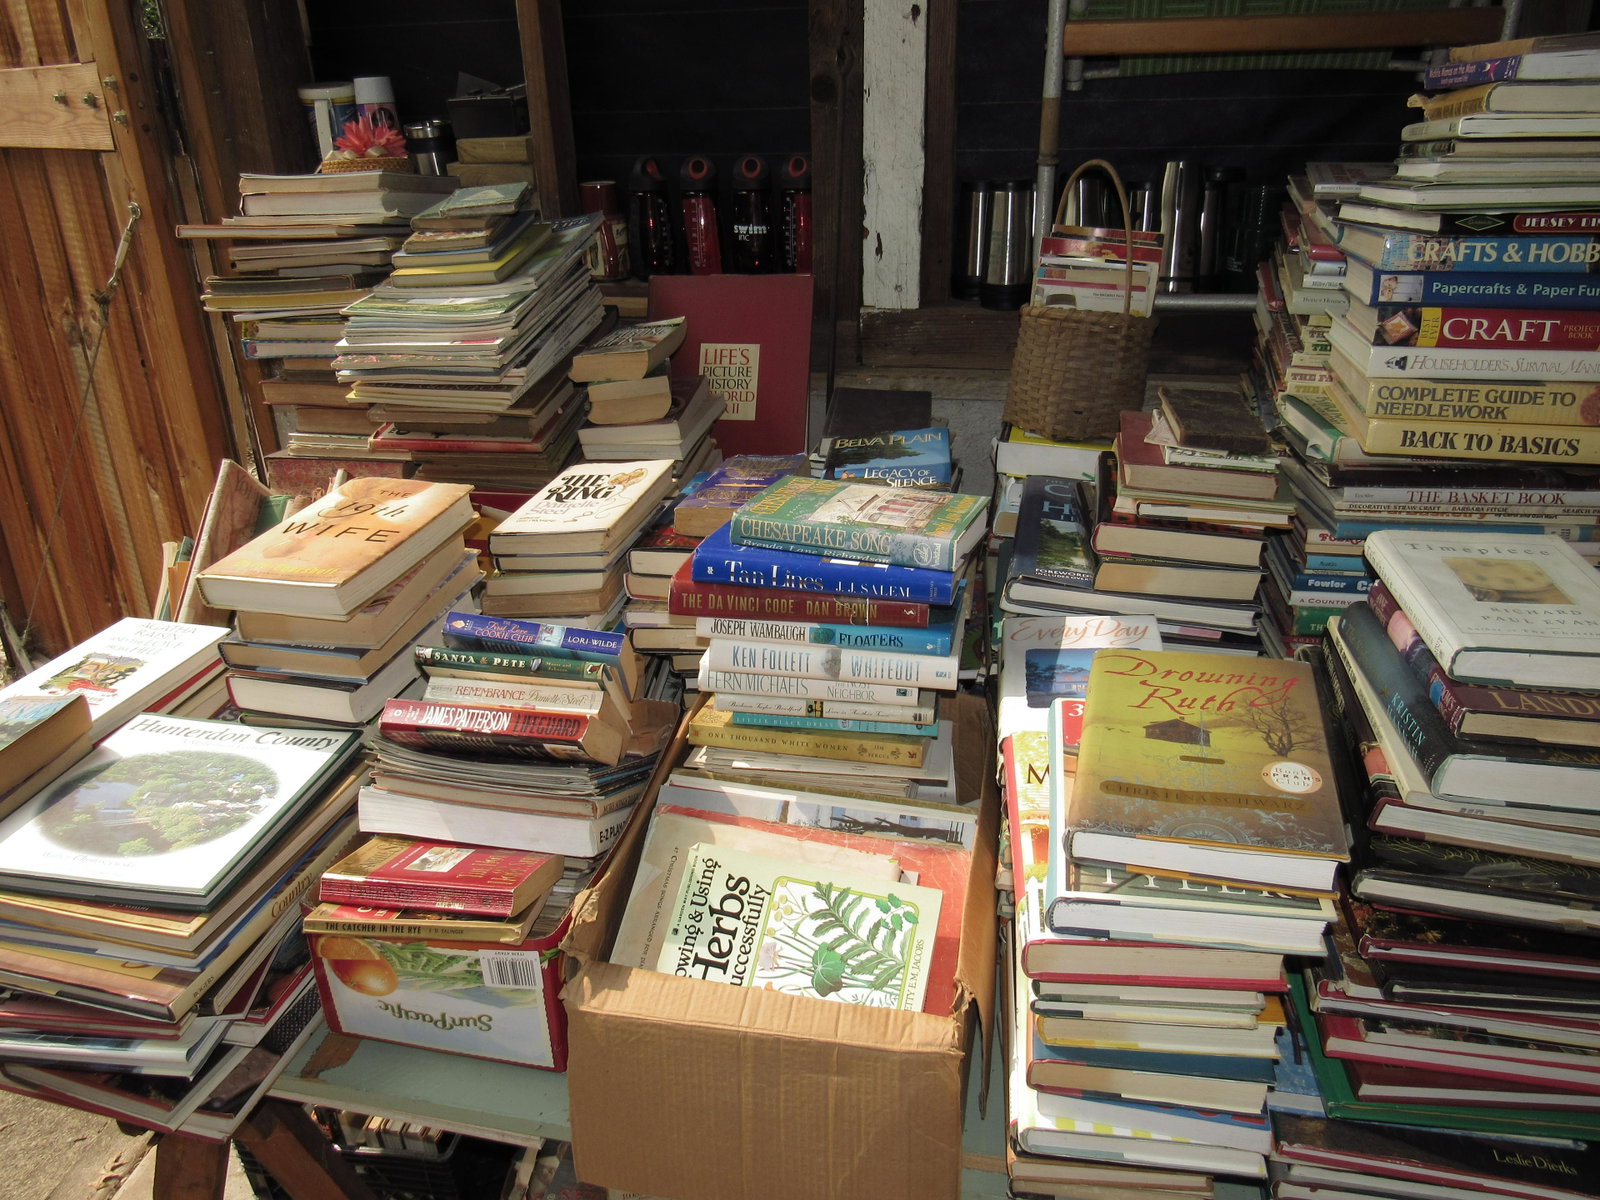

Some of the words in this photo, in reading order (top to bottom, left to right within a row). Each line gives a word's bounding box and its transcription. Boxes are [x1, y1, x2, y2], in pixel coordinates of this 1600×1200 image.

[734, 224, 768, 235] swim
[1522, 218, 1576, 228] JERSEY
[1408, 241, 1498, 263] CRAFTS
[1502, 242, 1522, 263] &
[1432, 281, 1511, 296] Papercrafts
[1516, 283, 1527, 295] &
[1533, 283, 1575, 298] Paper
[1421, 319, 1430, 338] BEST
[1430, 317, 1440, 339] EVER
[1442, 317, 1560, 342] CRAFT
[704, 347, 750, 366] LIFE'S
[702, 366, 752, 377] PICTURE
[1377, 385, 1482, 405] COMPLETE
[1485, 389, 1544, 406] GUIDE
[1548, 391, 1577, 407] TO
[1375, 401, 1509, 420] NEEDLEWORK
[835, 436, 885, 449] BELVA
[889, 432, 941, 445] PLAIN
[1400, 430, 1457, 450] BACK
[1463, 433, 1493, 452] TO
[1499, 435, 1580, 457] BASICS
[562, 474, 610, 488] THE
[864, 468, 916, 479] LEGACY
[917, 469, 930, 477] OF
[886, 475, 937, 489] SILENCE
[378, 488, 412, 499] THE
[544, 485, 616, 504] RING
[1406, 490, 1443, 503] THE
[1448, 491, 1514, 504] BASKET
[1518, 492, 1566, 505] BOOK
[317, 501, 406, 519] 19th
[282, 521, 401, 544] WIFE
[741, 518, 846, 549] CHESAPEAKE
[850, 531, 892, 555] SONG
[742, 539, 783, 550] Brenda
[789, 545, 819, 555] Lane
[823, 551, 890, 564] Richardson
[1405, 542, 1552, 556] Timepiece
[725, 560, 764, 586] Tan
[771, 564, 824, 591] Lines
[835, 580, 844, 593] J.
[848, 582, 857, 594] J.
[861, 583, 911, 599] SALEM
[1308, 580, 1346, 588] Fowler
[681, 593, 703, 609] THE
[708, 595, 724, 610] DA
[725, 595, 759, 611] VINCI
[764, 598, 795, 614] CODE
[806, 600, 830, 616] DAN
[835, 601, 878, 619] BROWN
[1490, 607, 1582, 616] RICHARD
[1481, 615, 1534, 625] PAUL
[475, 629, 509, 640] COOKIE
[511, 633, 534, 643] CLUB
[711, 618, 746, 636] JOSEPH
[750, 621, 806, 642] WAMBAUGH
[839, 633, 904, 648] FLOATERS
[1010, 619, 1087, 647] Every
[1086, 616, 1149, 645] Day
[568, 636, 588, 645] LORI
[592, 639, 617, 649] WILDE
[435, 651, 475, 665] SANTA
[480, 656, 488, 665] &
[493, 657, 526, 669] PETE
[732, 645, 756, 669] KEN
[761, 649, 811, 674] FOLLETT
[851, 655, 921, 683] WHITEOUT
[707, 672, 743, 692] FERN
[1095, 654, 1299, 708] Drowning
[455, 686, 525, 701] REMEMBRANCE
[827, 686, 876, 702] NEIGHBOR
[1128, 679, 1235, 715] Ruth
[419, 705, 456, 725] JAMES
[455, 708, 512, 732] PATTERSON
[513, 713, 581, 738] LIFEGUARD
[736, 717, 769, 725] LITTLE
[773, 718, 801, 727] BLACK
[806, 720, 835, 728] DRESS
[1392, 692, 1426, 746] KRISTIN
[130, 718, 253, 744] Hunterdon
[255, 731, 340, 751] County
[708, 732, 725, 740] ONE
[730, 733, 777, 745] THOUSAND
[782, 740, 810, 748] WHITE
[815, 743, 849, 752] WOMEN
[1105, 784, 1207, 805] CHRISTINA
[1213, 794, 1305, 811] SCHWARZ
[690, 858, 722, 907] Using
[271, 872, 313, 919] Country
[688, 910, 704, 923] &
[692, 873, 751, 980] Herbs
[325, 922, 340, 931] THE
[342, 923, 376, 933] CATCHER
[379, 924, 389, 933] IN
[390, 925, 405, 934] THE
[407, 926, 422, 935] RYE
[730, 884, 772, 987] uccessfully
[675, 924, 704, 978] owing
[904, 990, 915, 1011] ETTY
[911, 939, 925, 972] JACOBS
[377, 998, 493, 1033] SunPacific
[1492, 1147, 1532, 1167] Leslie
[1532, 1155, 1578, 1175] Dierks
